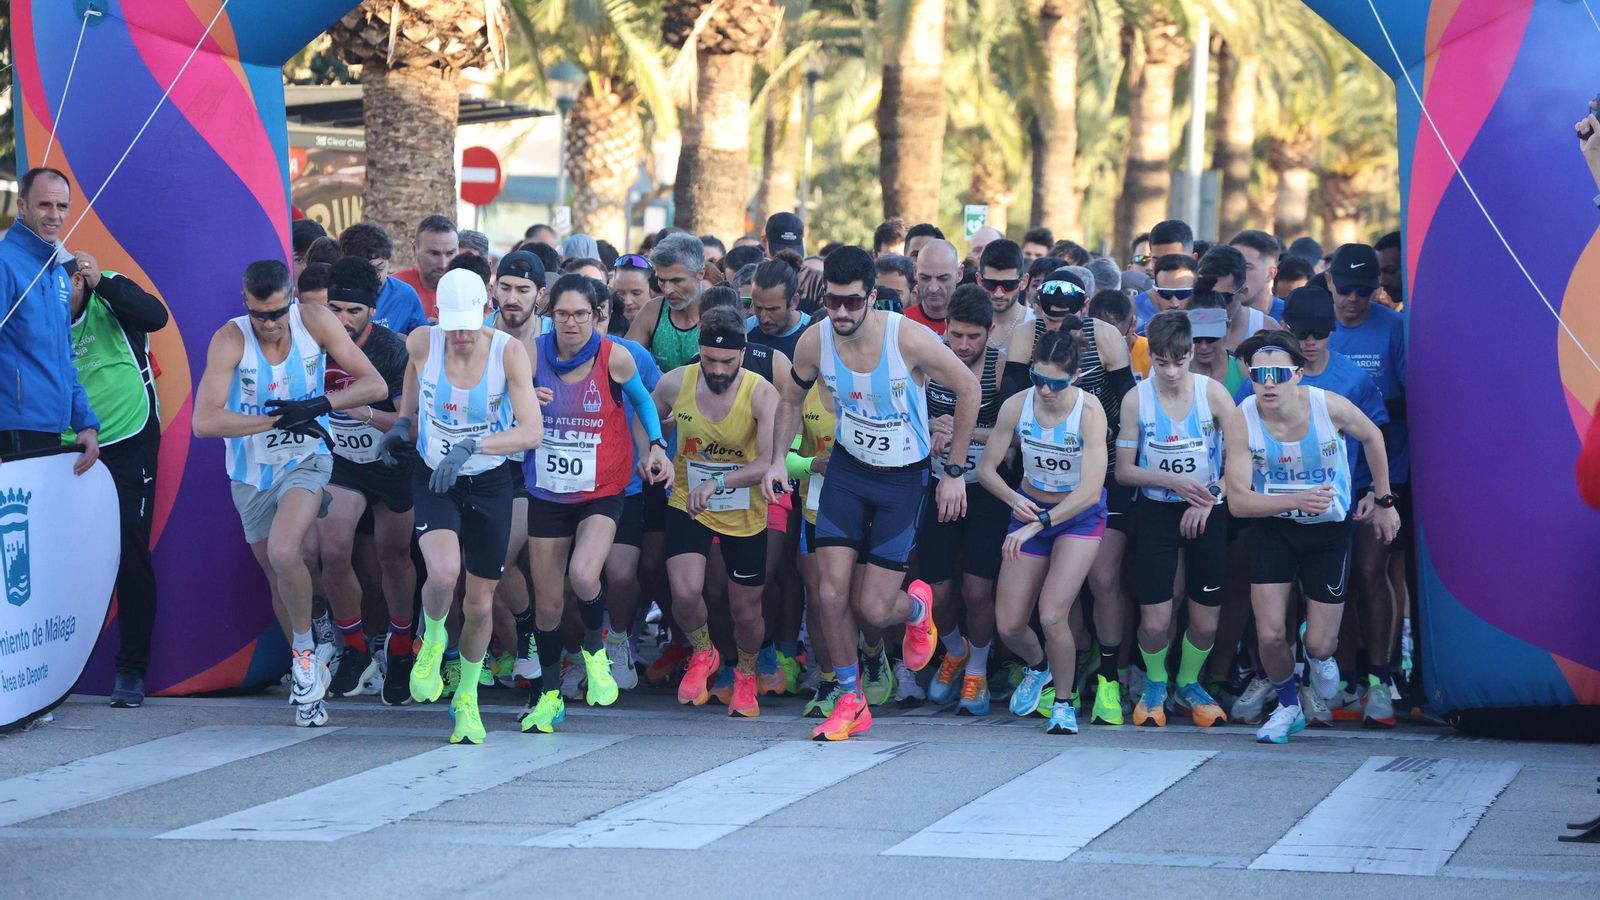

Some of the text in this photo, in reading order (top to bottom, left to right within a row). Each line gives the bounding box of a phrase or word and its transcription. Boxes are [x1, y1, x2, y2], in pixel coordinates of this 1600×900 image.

[326, 137, 346, 146] Clear
[555, 417, 604, 428] ATLETISMO
[677, 412, 693, 422] vive
[805, 412, 820, 421] vive
[265, 430, 305, 449] 220
[335, 433, 373, 450] 500
[853, 429, 891, 452] 573
[703, 440, 744, 458] Álora
[546, 454, 583, 476] 590
[1034, 456, 1072, 471] 190
[1159, 457, 1197, 474] 463
[32, 622, 43, 647] de
[45, 615, 76, 642] Málaga
[1, 663, 48, 692] Área de Deporte
